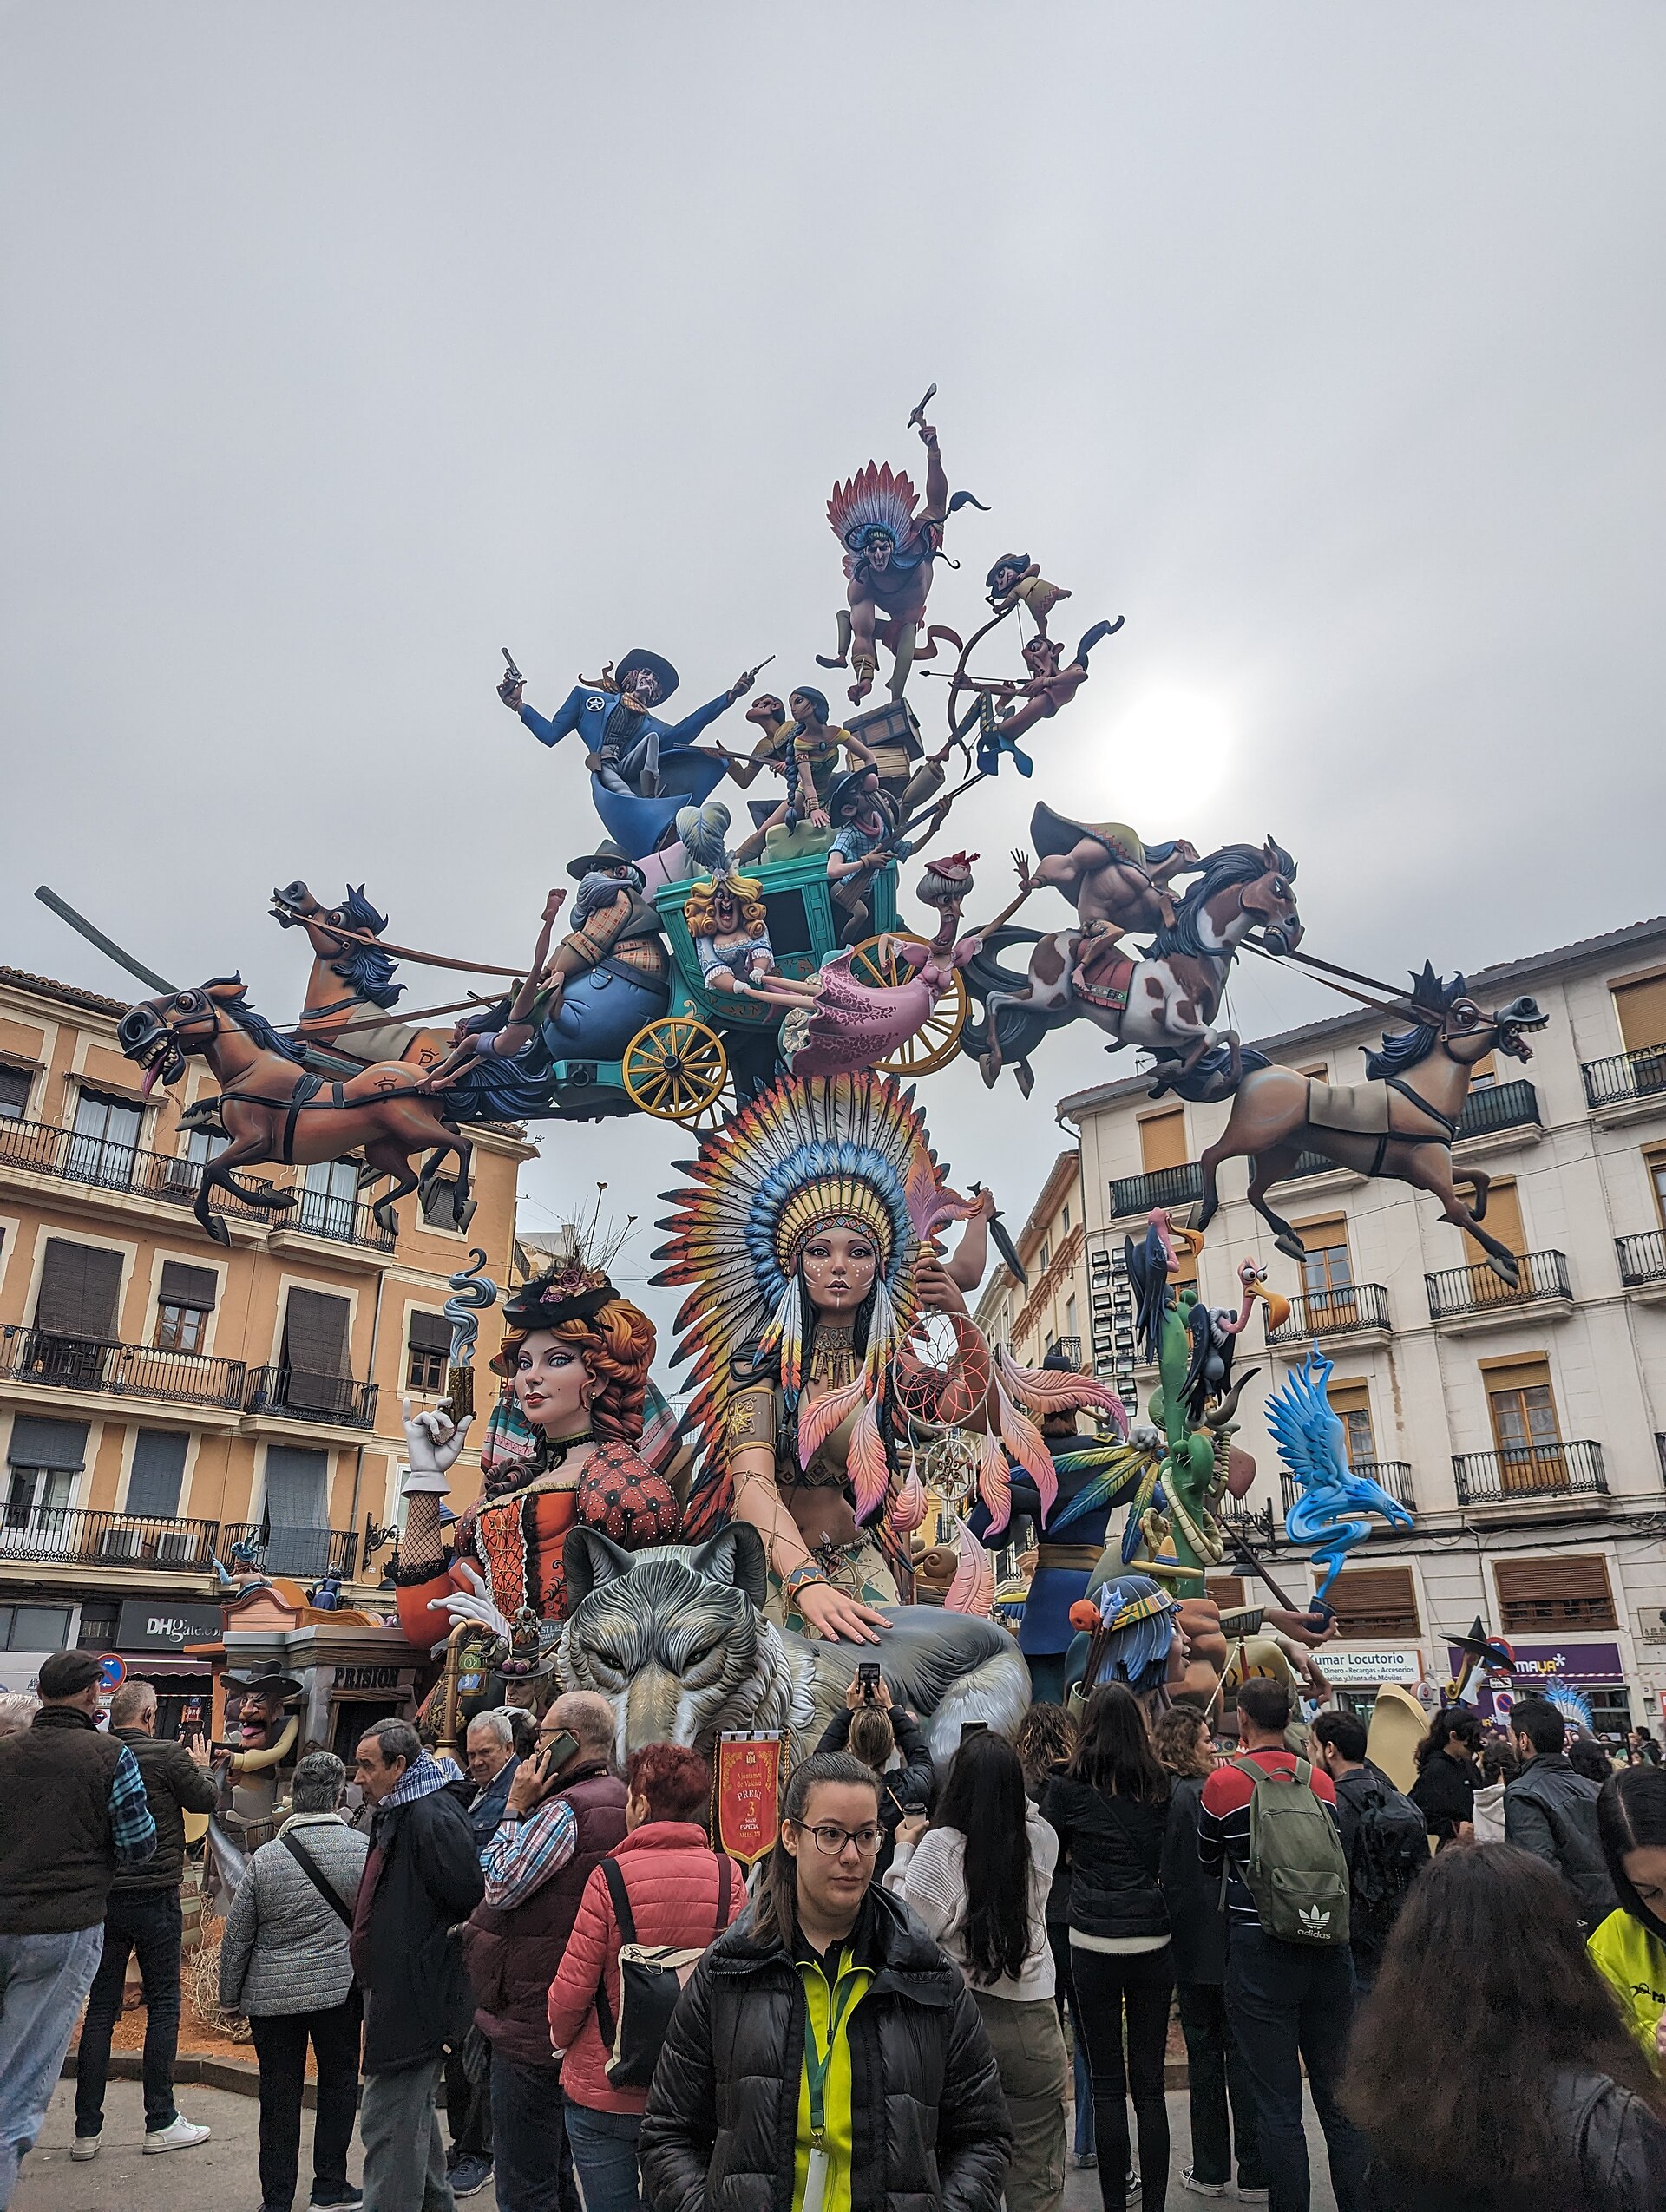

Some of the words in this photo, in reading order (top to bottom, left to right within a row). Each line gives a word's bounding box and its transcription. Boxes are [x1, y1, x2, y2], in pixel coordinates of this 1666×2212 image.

[1348, 1652, 1404, 1665] Locutorio
[737, 1789, 762, 1801] PREMI
[747, 1801, 755, 1816] 3
[1297, 1929, 1331, 1939] adidas
[1652, 1991, 1666, 2004] ra
